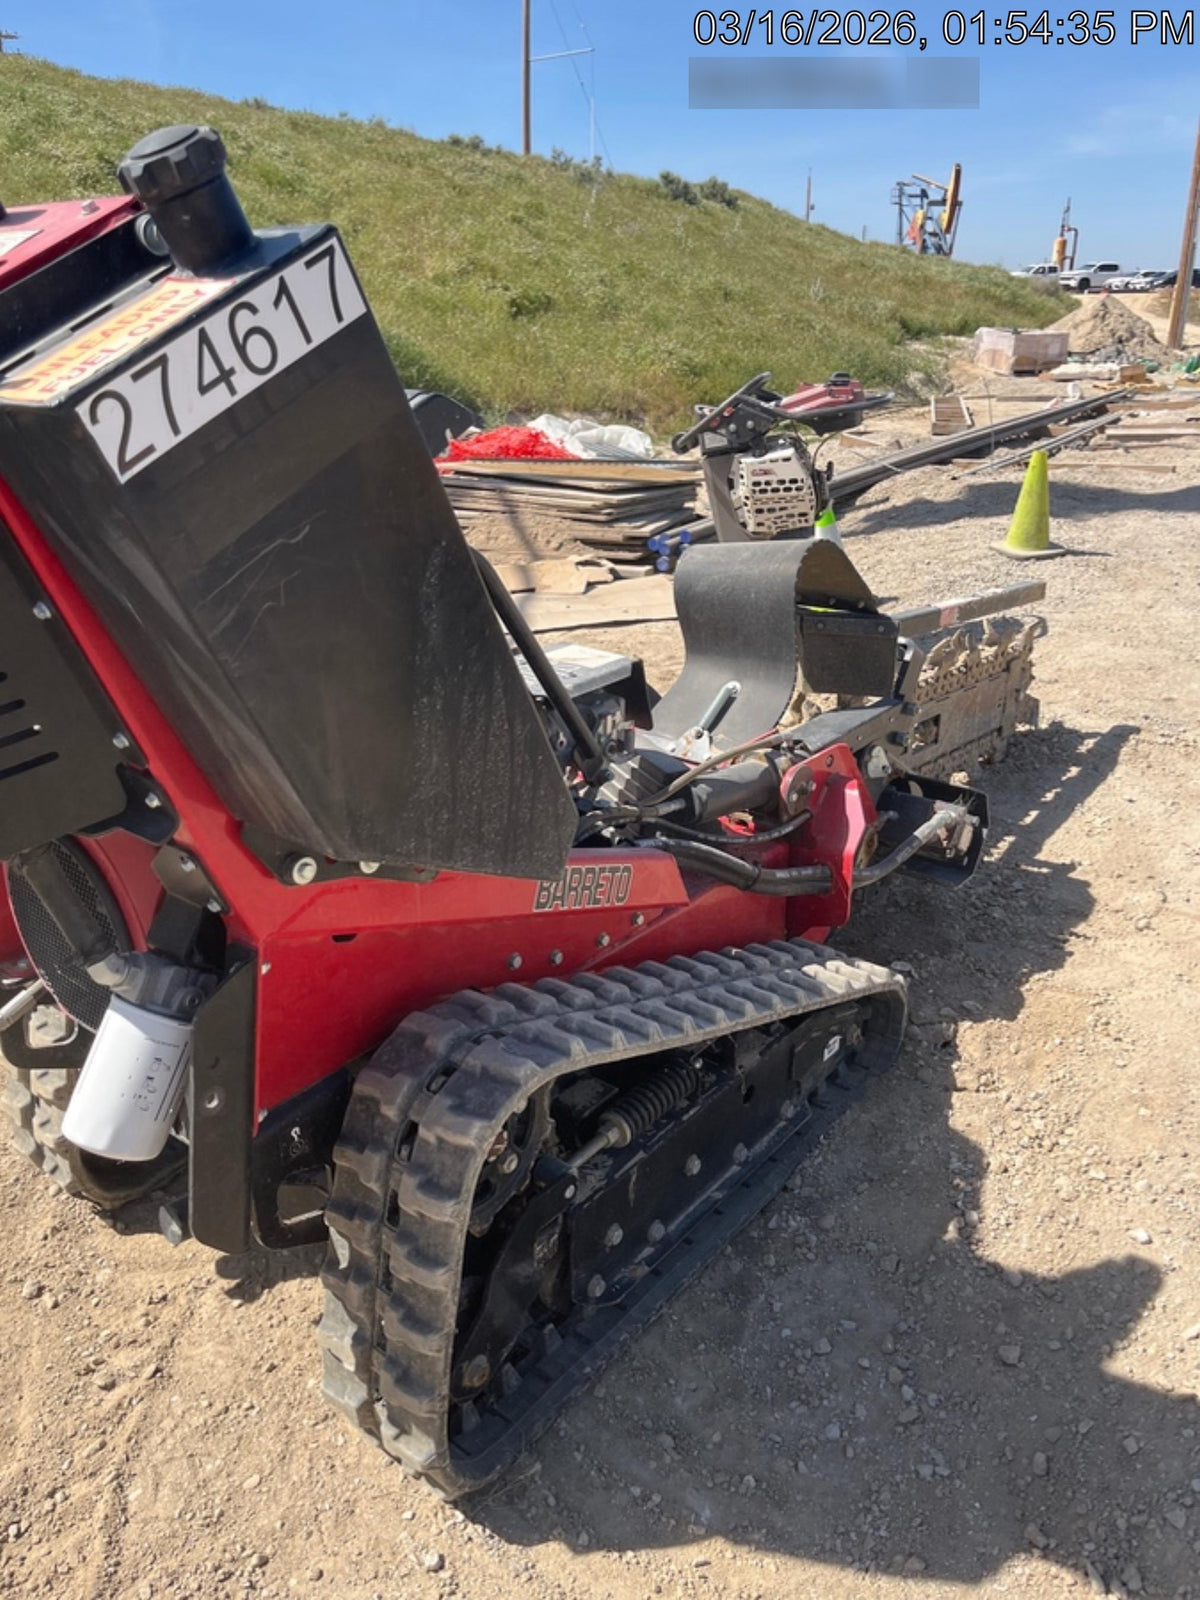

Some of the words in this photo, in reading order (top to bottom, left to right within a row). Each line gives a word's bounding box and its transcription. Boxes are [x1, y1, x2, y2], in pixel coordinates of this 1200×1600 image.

[15, 288, 180, 392] UNLEADED
[39, 342, 128, 393] FUEL
[128, 288, 206, 338] ONLY
[88, 243, 345, 475] 274617
[533, 864, 633, 912] BARRETO
